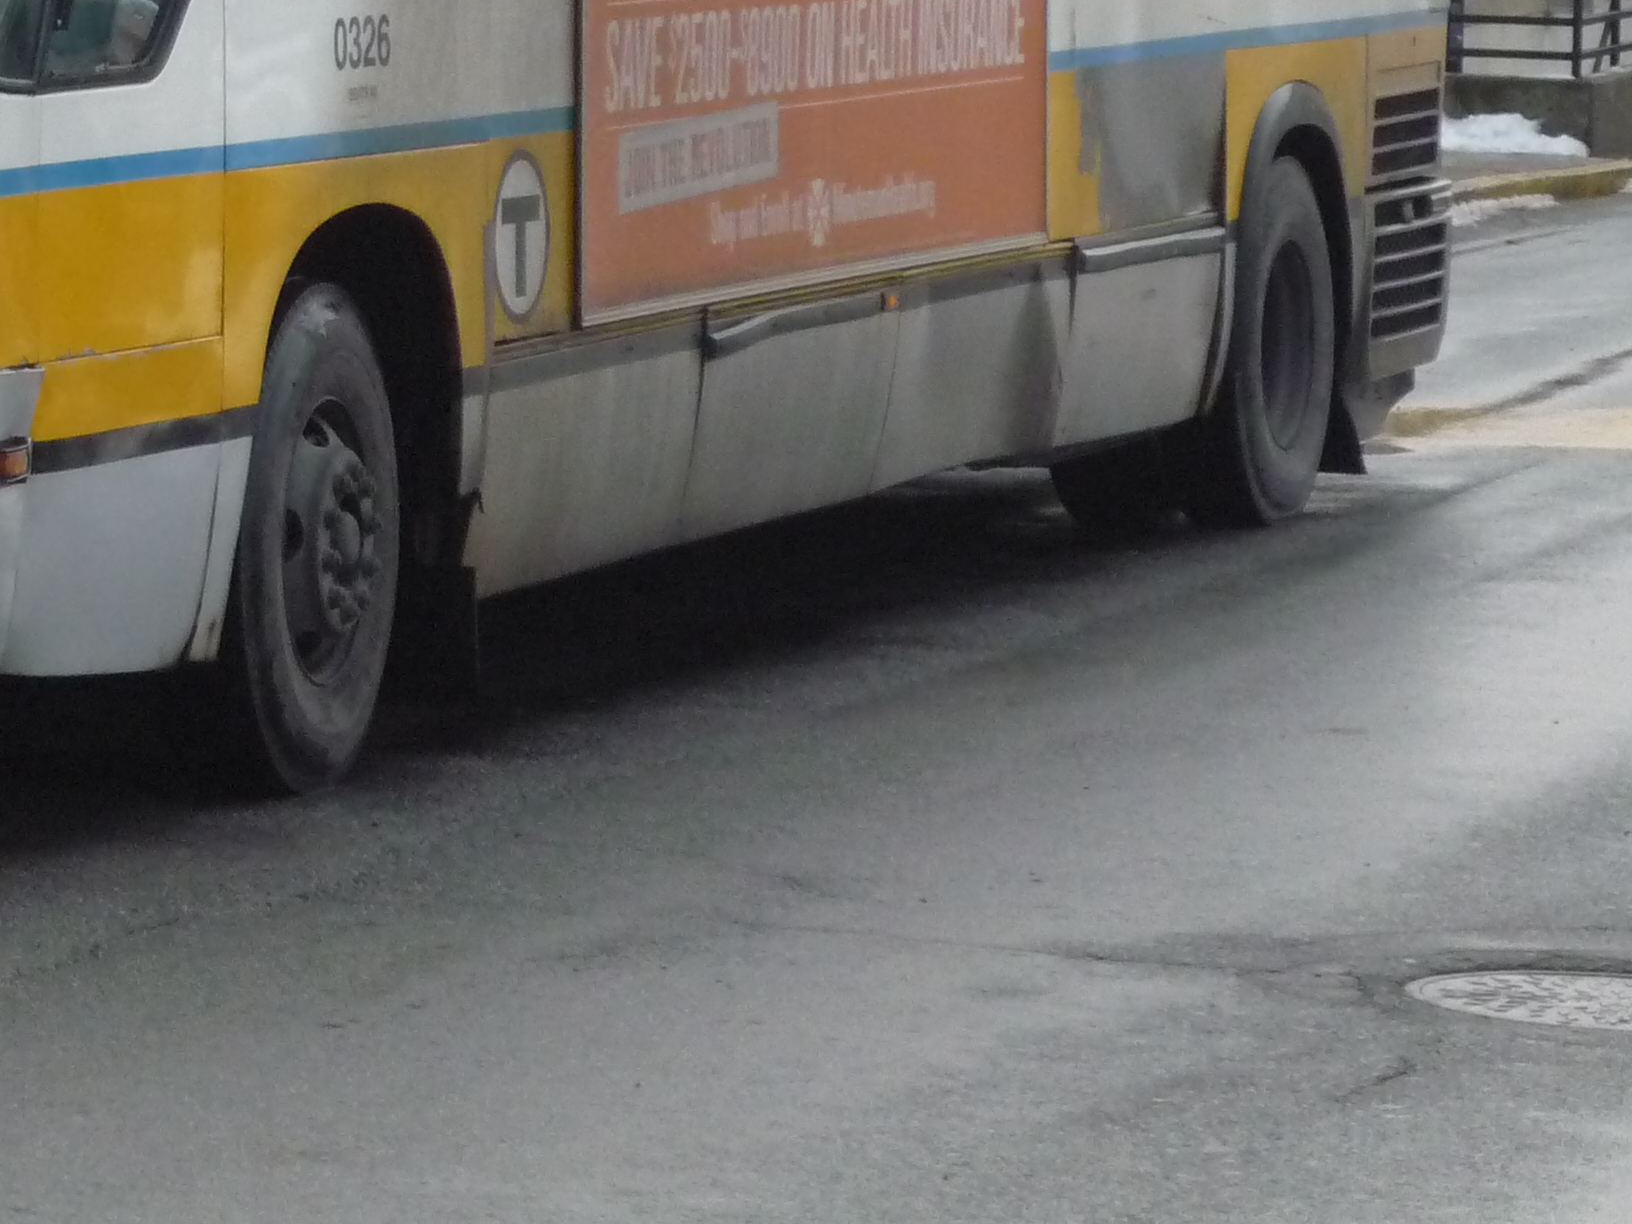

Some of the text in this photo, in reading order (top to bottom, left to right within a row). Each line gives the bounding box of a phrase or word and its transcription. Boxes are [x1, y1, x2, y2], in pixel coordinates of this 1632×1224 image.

[334, 14, 391, 70] 0326
[605, 16, 664, 113] SAVE
[806, 0, 835, 89] ON
[501, 194, 540, 298] T
